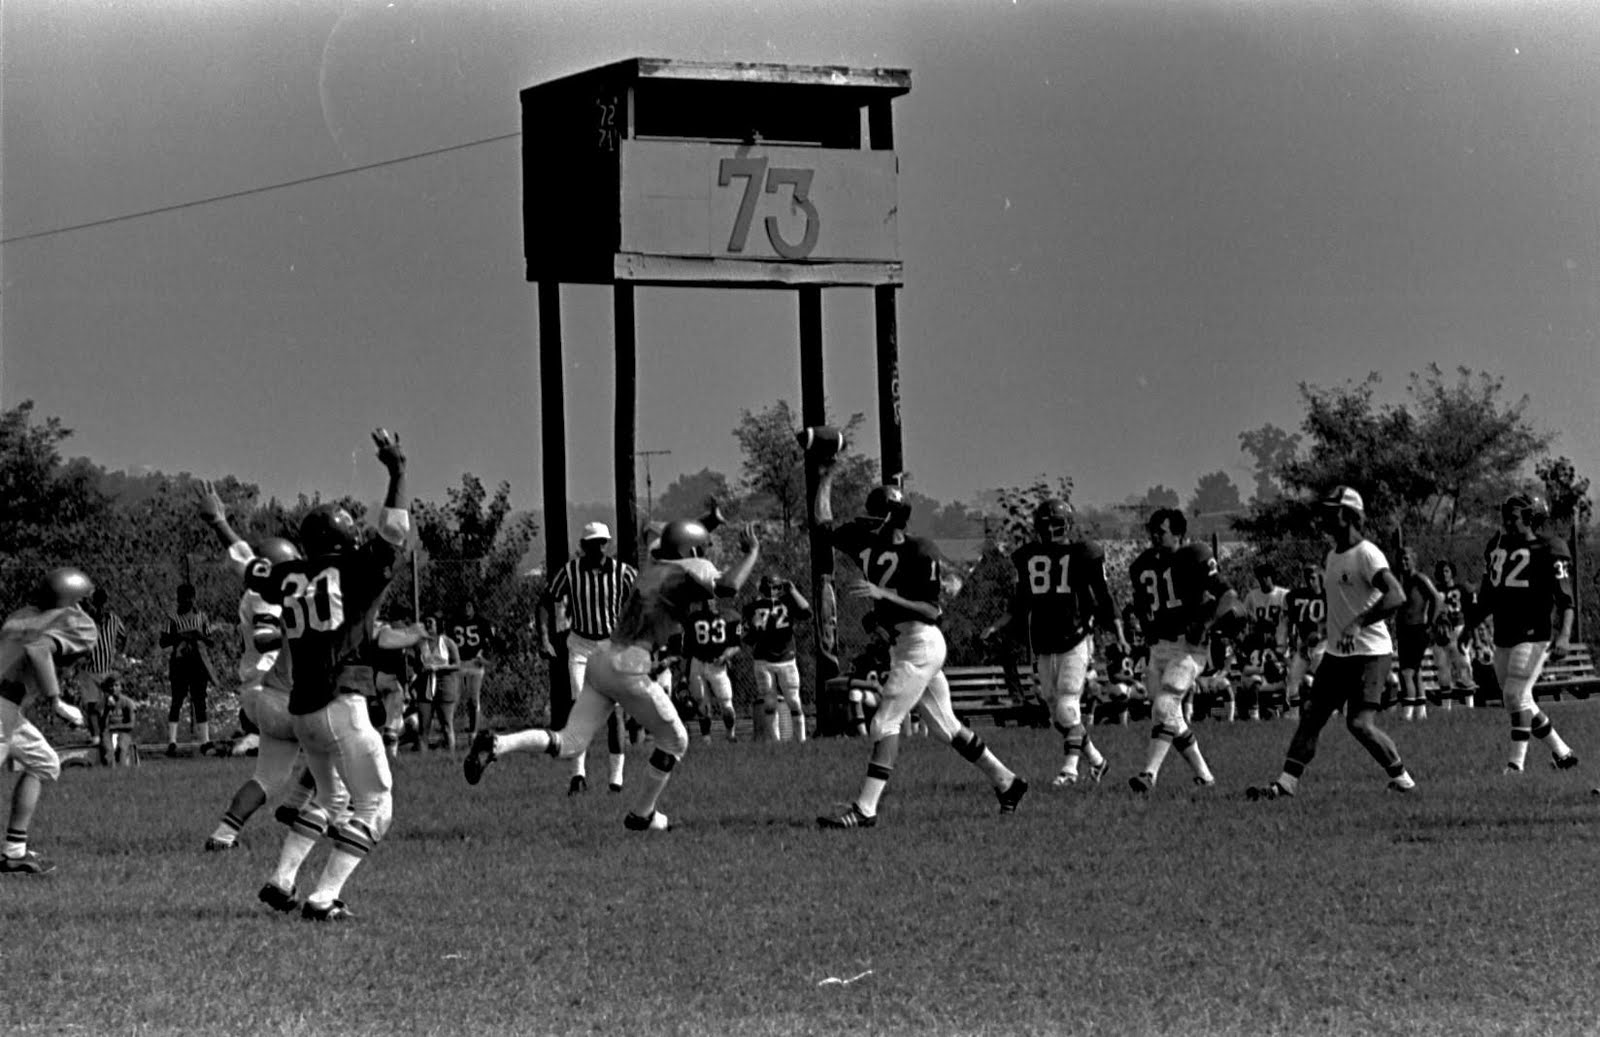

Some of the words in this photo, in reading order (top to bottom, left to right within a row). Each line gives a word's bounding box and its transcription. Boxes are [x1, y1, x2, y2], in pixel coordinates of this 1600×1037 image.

[717, 156, 820, 259] 73
[859, 547, 899, 597] 12
[1027, 554, 1072, 595] 81
[1489, 547, 1531, 588] 32
[281, 566, 345, 639] 30
[1139, 566, 1183, 621] 31
[1294, 598, 1325, 622] 70
[694, 618, 727, 645] 83
[752, 603, 790, 632] 72
